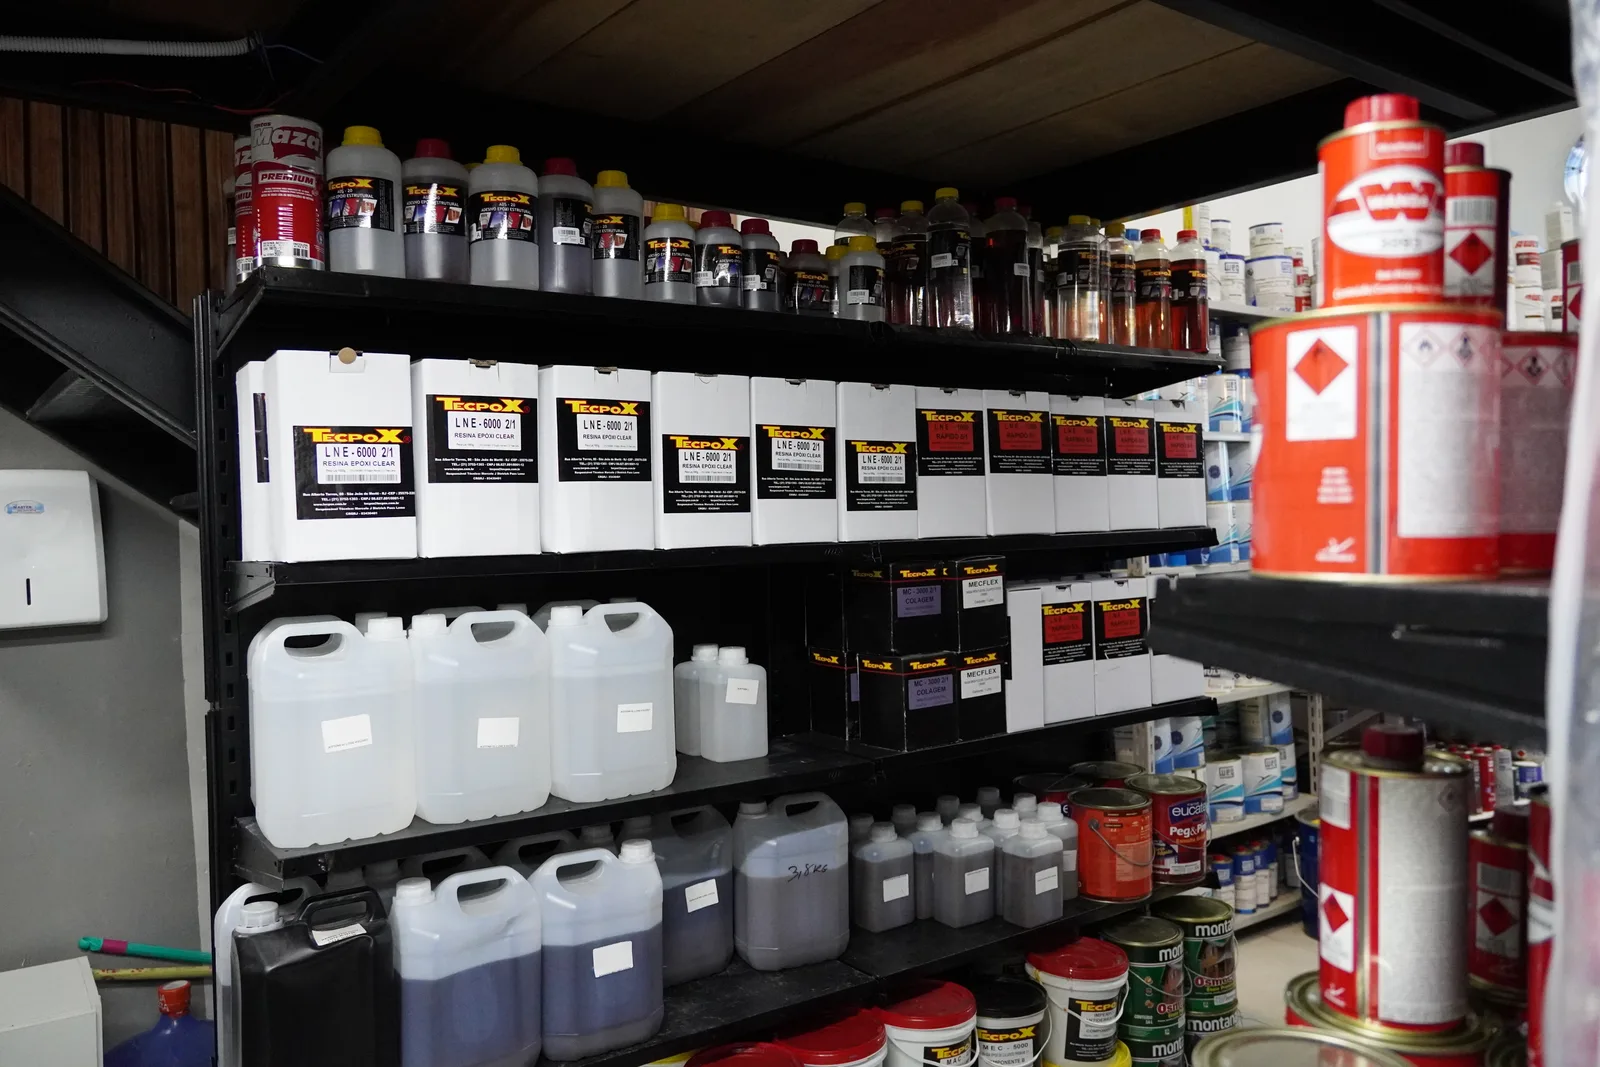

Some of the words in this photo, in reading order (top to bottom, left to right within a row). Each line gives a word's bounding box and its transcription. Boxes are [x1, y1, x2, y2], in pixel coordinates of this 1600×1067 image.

[252, 126, 320, 151] Maza
[261, 172, 315, 185] PREMIUM
[405, 185, 459, 197] TECOX
[480, 193, 530, 205] TECPOX
[435, 396, 525, 413] TECPOX
[564, 400, 639, 416] TECPOX
[921, 410, 976, 422] TECPOX
[992, 411, 1044, 423] TECPOX
[1052, 415, 1098, 427] TECPOX
[483, 418, 502, 429] 6000
[505, 419, 516, 429] 2/1
[1109, 417, 1150, 429] TECPOX
[1159, 423, 1198, 433] TECPOX
[303, 428, 404, 443] TECPOX
[762, 425, 826, 440] TECPOX
[669, 436, 740, 450] TECPOX
[851, 441, 908, 454] TECPOX
[356, 446, 377, 458] 6000
[381, 446, 393, 458] 2/1
[900, 568, 937, 578] TECPOX
[964, 564, 999, 575] TECPOX
[968, 579, 999, 588] MECFLEX
[905, 596, 934, 604] COLAGEM
[1098, 599, 1141, 612] TECPOX
[1042, 602, 1085, 616] TECPOX
[812, 652, 839, 664] TECPOX
[910, 657, 947, 670] TECPOX
[964, 652, 998, 665] TECPOX
[862, 659, 894, 671] TECPOX
[966, 668, 997, 678] MECFLEX
[916, 686, 946, 696] COLAGEM
[1075, 1000, 1117, 1011] TECPO
[931, 1042, 969, 1059] TECPO
